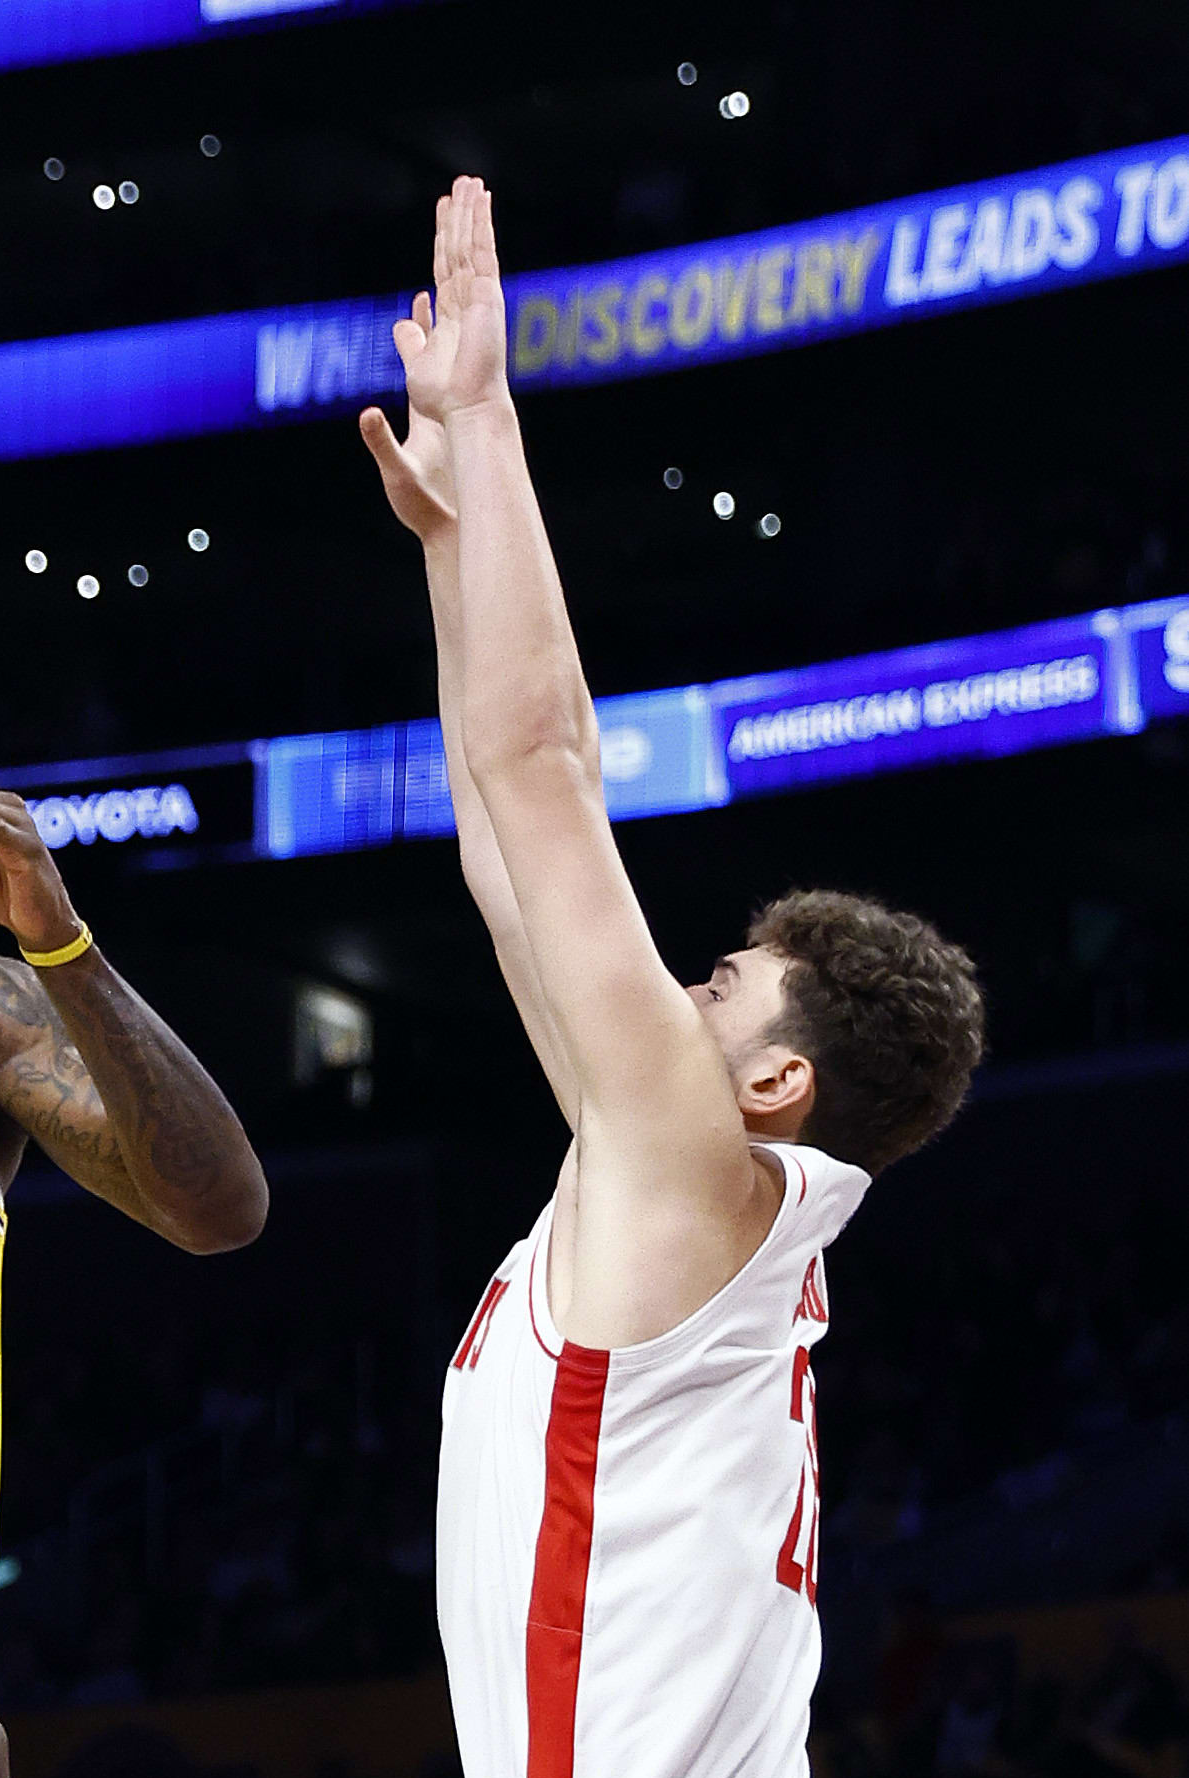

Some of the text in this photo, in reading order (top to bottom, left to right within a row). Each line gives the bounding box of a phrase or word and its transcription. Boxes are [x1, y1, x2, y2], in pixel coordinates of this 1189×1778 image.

[514, 225, 881, 378] DISCOVERY
[883, 180, 1105, 308] LEADS
[727, 682, 923, 764] AMERICAN
[921, 652, 1103, 728] EXPRESS
[25, 784, 199, 848] OYOTA
